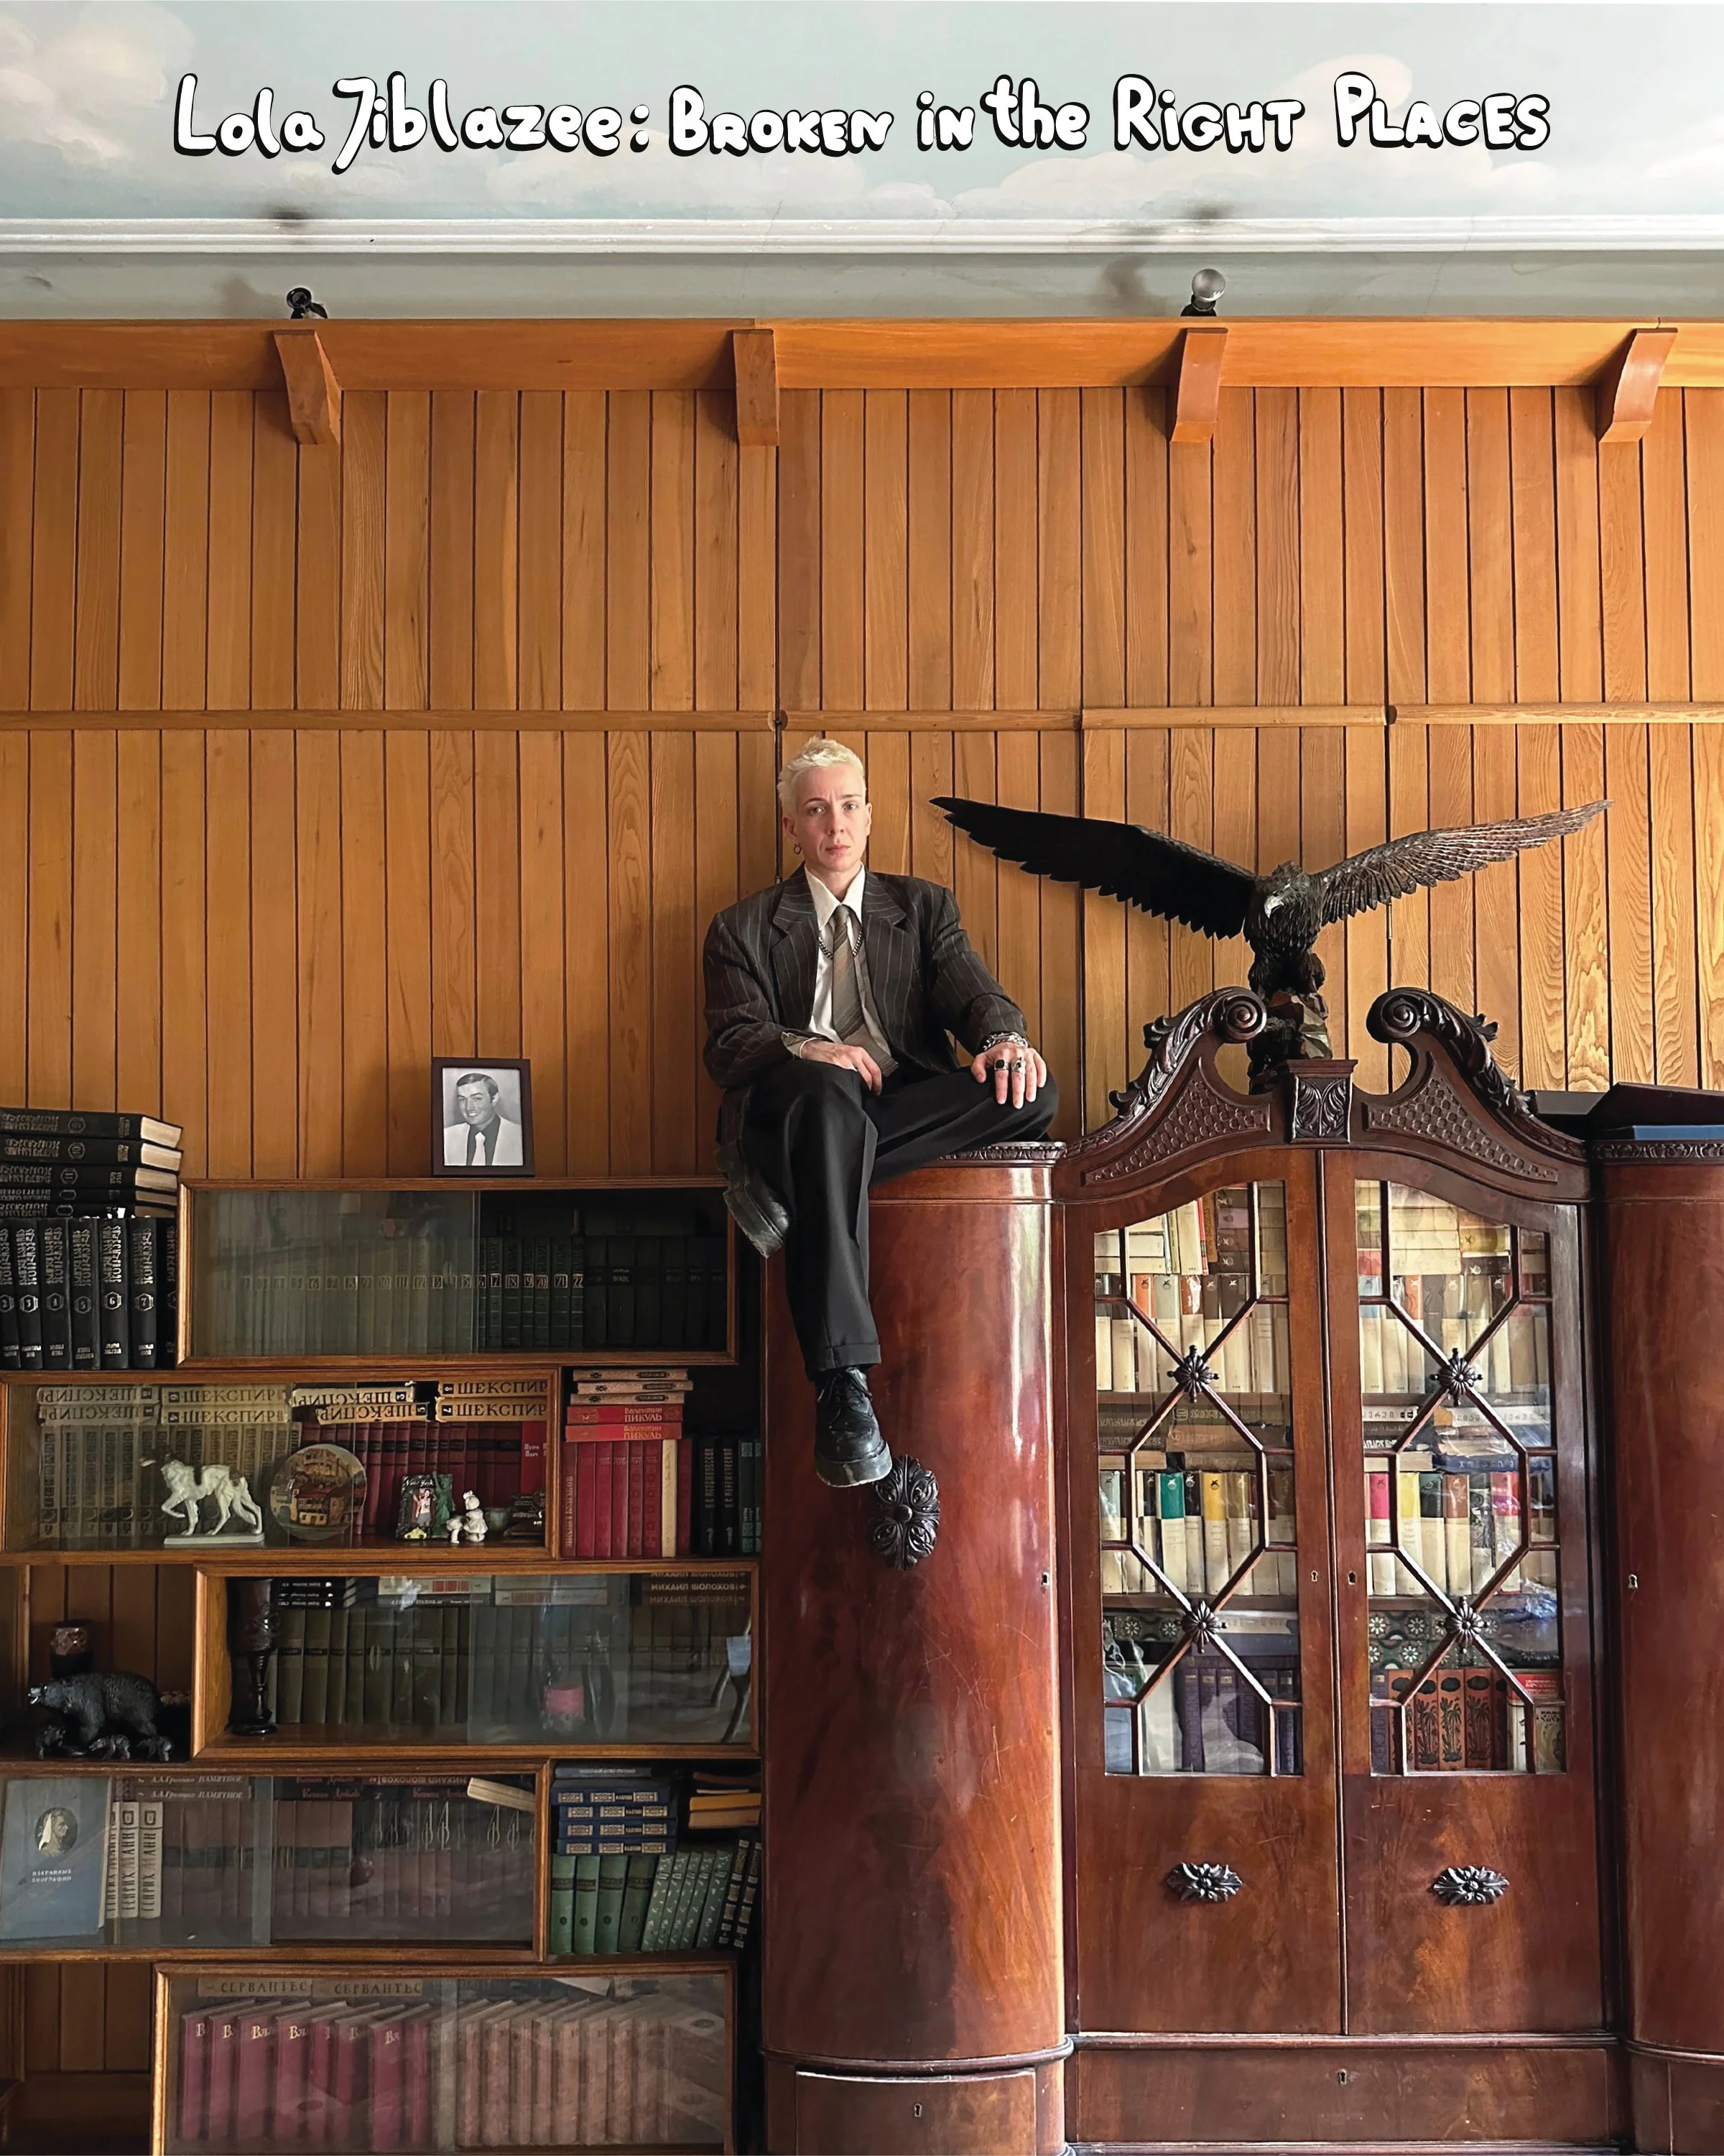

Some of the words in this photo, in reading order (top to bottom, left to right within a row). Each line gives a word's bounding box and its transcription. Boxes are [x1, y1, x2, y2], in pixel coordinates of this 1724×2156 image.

[506, 1276, 518, 1287] 18
[458, 1381, 548, 1394] ШЕКСПИР
[45, 1388, 137, 1402] ШЕКСПИР
[183, 1389, 276, 1403] ШЕКСПИР
[49, 1405, 138, 1420] ШЕКСПИР
[320, 1405, 412, 1420] ШЕКСПИР
[456, 1402, 547, 1417] ШЕКСПИР
[183, 1410, 277, 1423] ШЕКСПИР
[624, 1431, 662, 1440] ПИКУЛЬ
[221, 1981, 307, 1994] СЕРВАНТЕС
[334, 1981, 422, 1994] СЕРВАНТЕС
